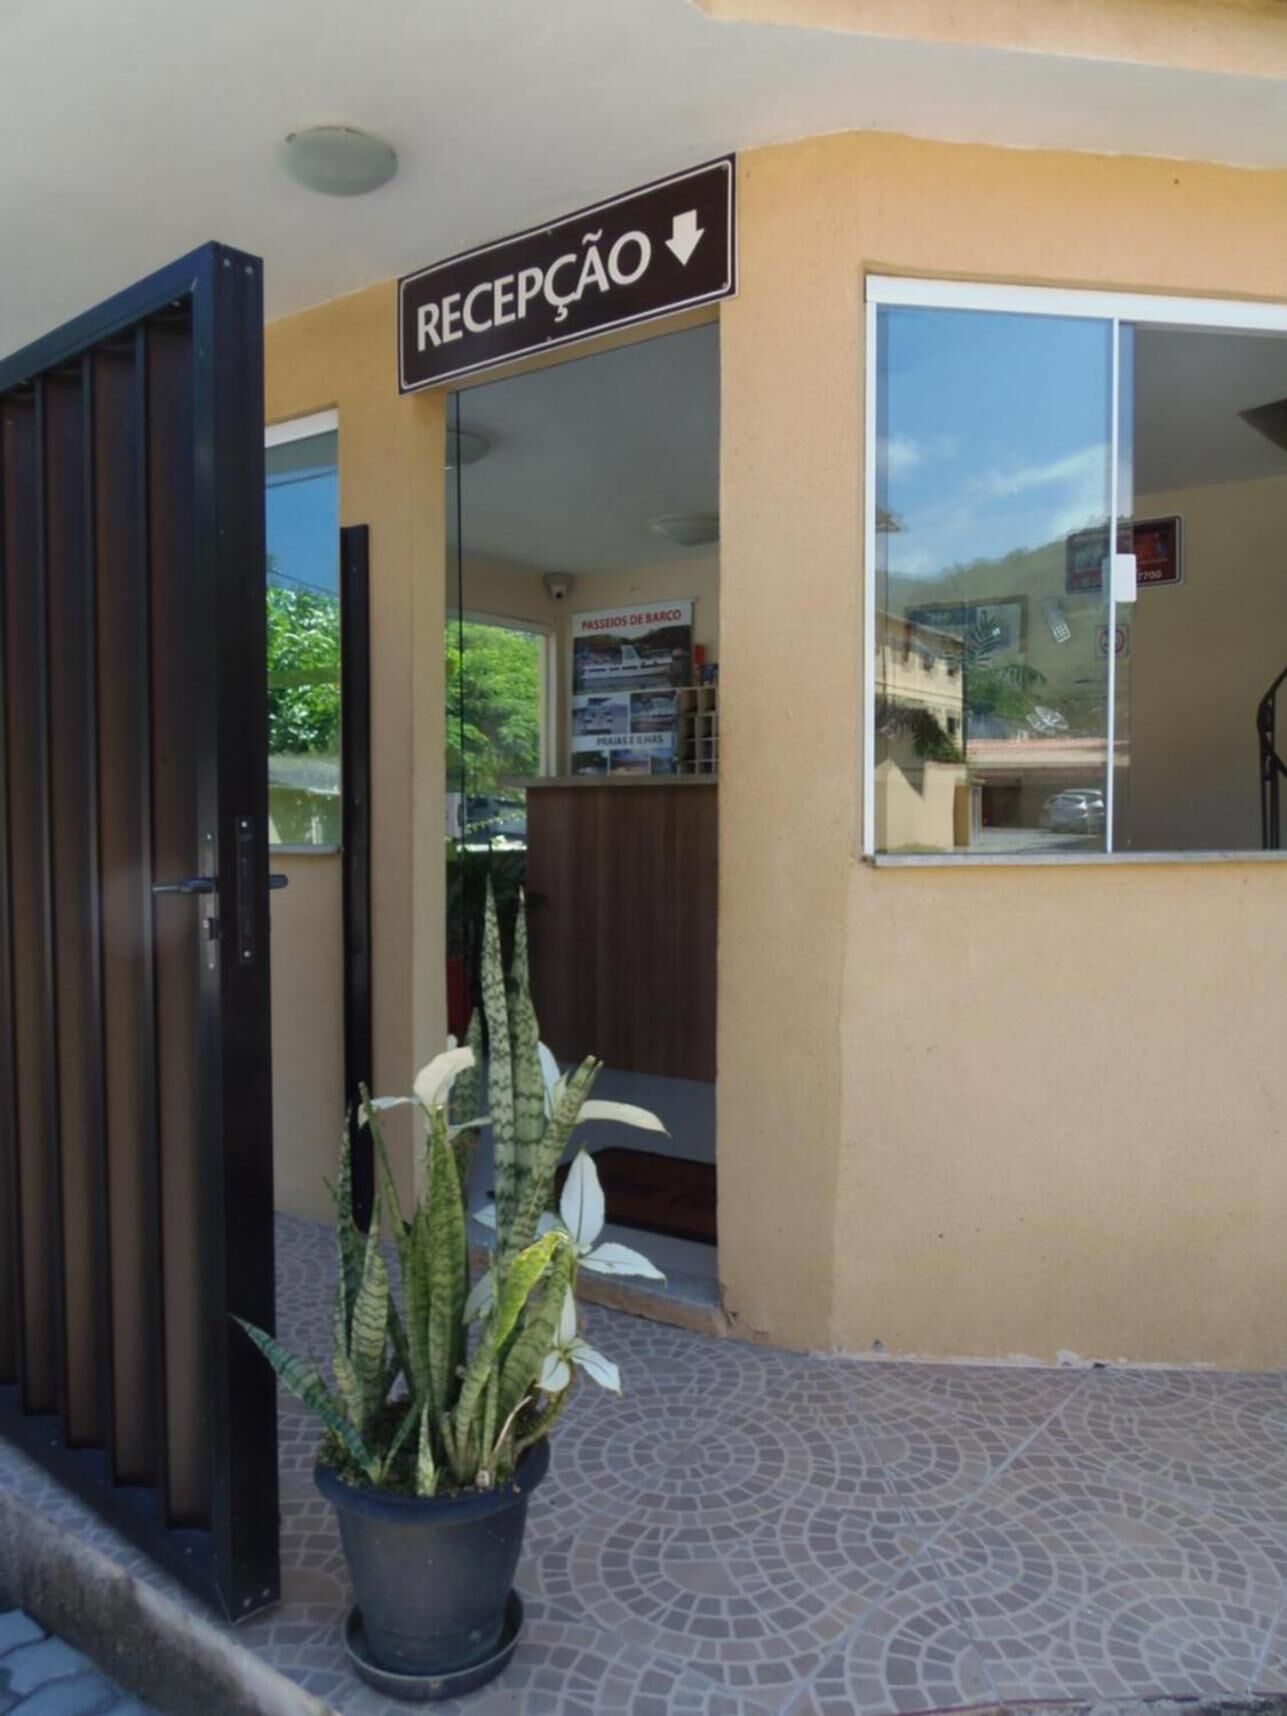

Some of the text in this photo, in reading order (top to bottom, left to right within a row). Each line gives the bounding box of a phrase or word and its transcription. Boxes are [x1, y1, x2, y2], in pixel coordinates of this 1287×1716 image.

[417, 229, 652, 352] RECEPÇÃO
[582, 609, 681, 630] PASSEIOS DE BARCO
[597, 736, 627, 746] PRAIAS
[637, 734, 664, 745] ILHAS
